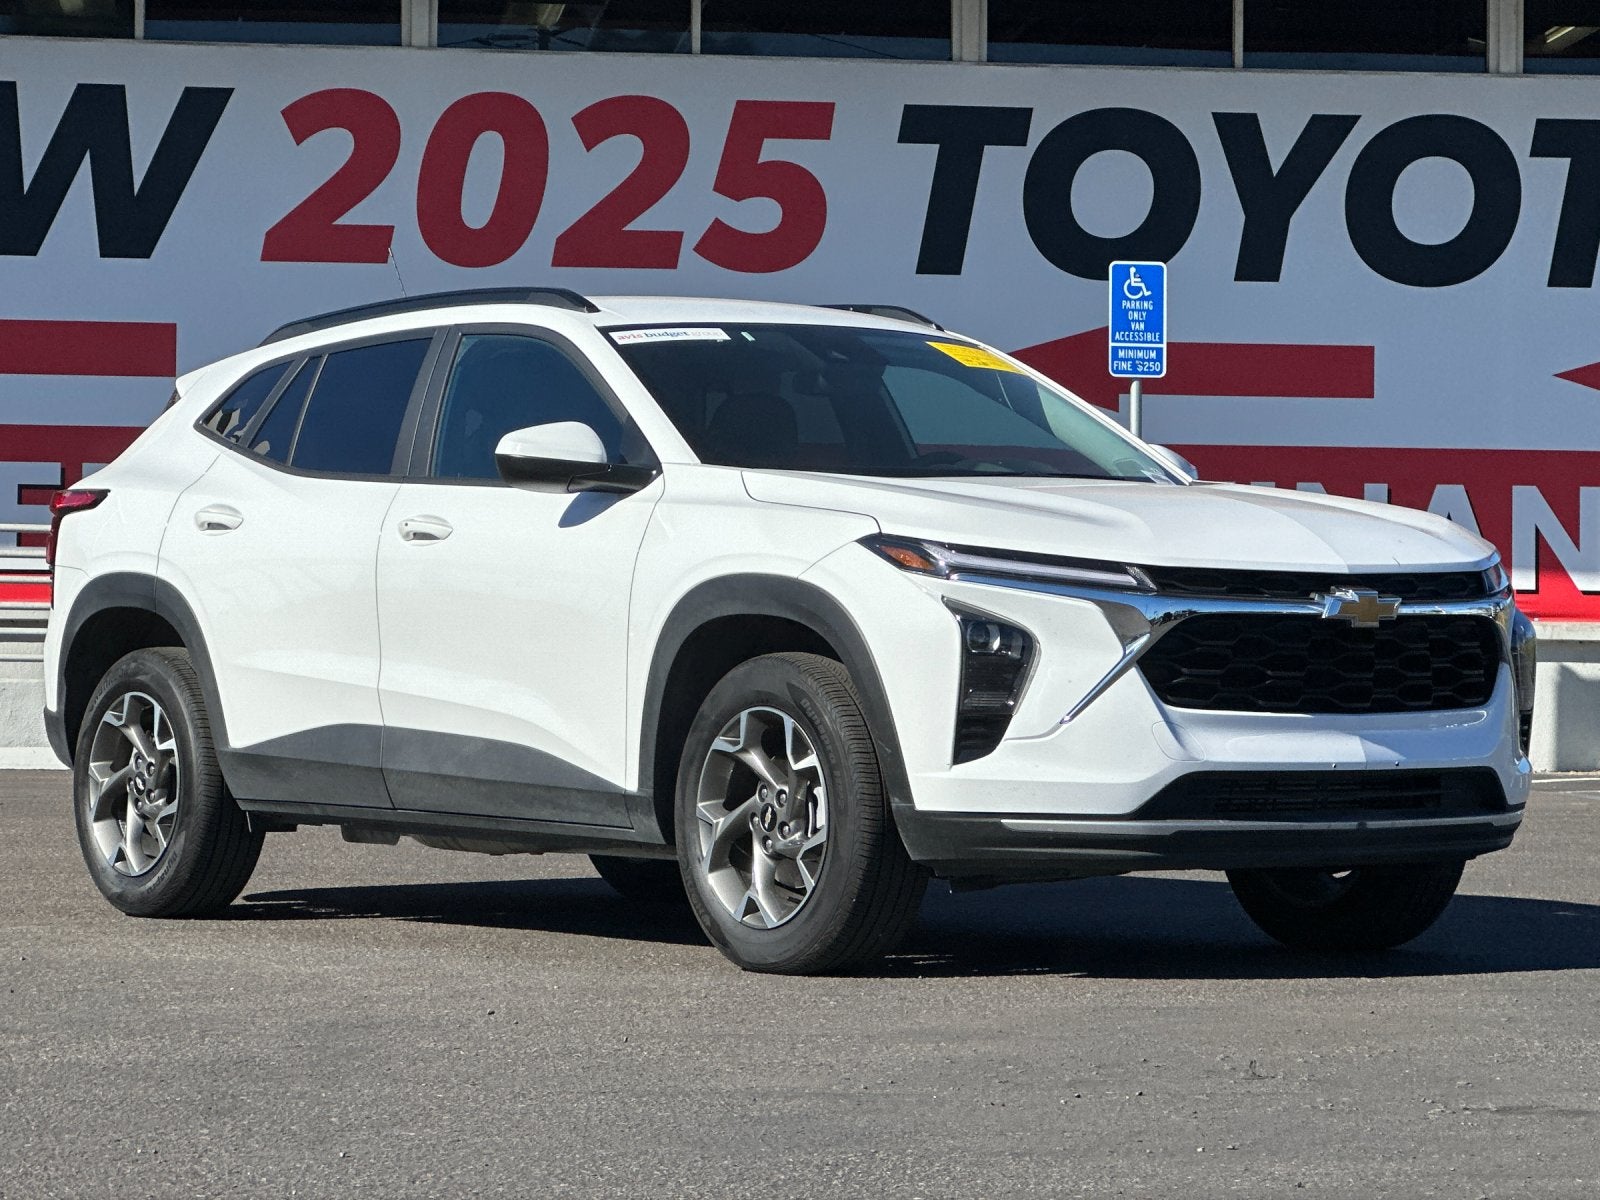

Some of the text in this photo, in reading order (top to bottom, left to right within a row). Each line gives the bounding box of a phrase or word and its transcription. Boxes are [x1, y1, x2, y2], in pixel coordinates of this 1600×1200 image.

[0, 80, 1600, 289] W 2025 TOYOT
[1121, 300, 1153, 310] PARKING
[1128, 310, 1147, 321] ONLY
[1130, 321, 1145, 331] VAN
[643, 330, 690, 338] budget
[1114, 331, 1160, 342] ACCESSIBLE
[1118, 348, 1157, 360] MINIMUM
[1113, 360, 1161, 372] FINE $250
